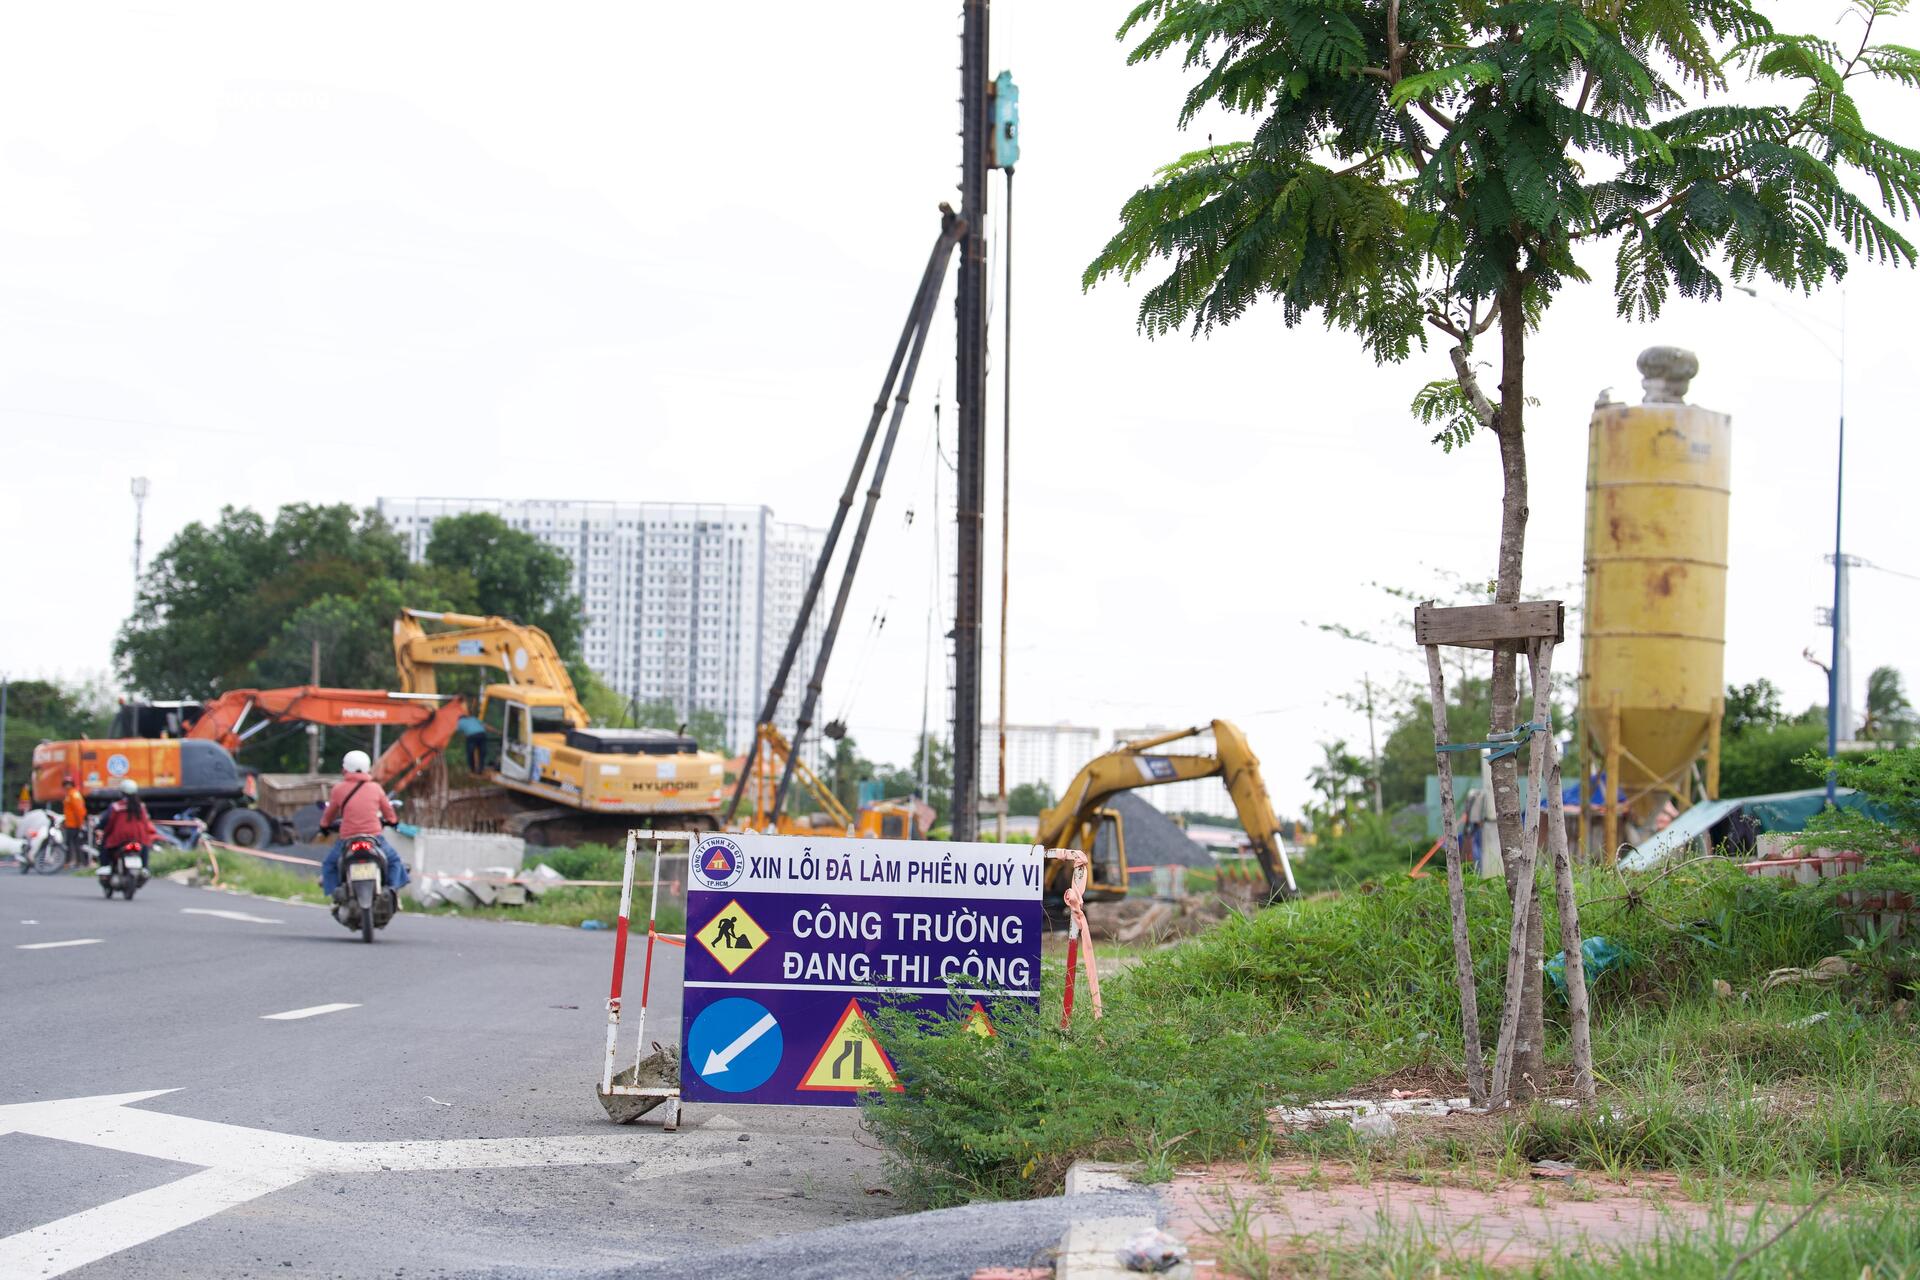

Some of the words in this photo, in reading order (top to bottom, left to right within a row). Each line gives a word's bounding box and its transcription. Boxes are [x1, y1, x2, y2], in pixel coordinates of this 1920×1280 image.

[342, 708, 388, 719] HITACHI
[632, 780, 699, 792] HYUNDAI
[707, 839, 725, 847] TNHH
[749, 856, 782, 879] XIN
[788, 847, 820, 881] LỖI
[826, 853, 853, 881] ĐÃ
[860, 854, 901, 883] LÀM
[908, 852, 967, 885] PHIỀN
[973, 858, 1015, 886] QUÝ
[1022, 864, 1040, 891] VỊ
[792, 903, 882, 941] CÔNG
[892, 907, 1023, 944] TRƯỜNG
[783, 951, 870, 982] ĐANG
[880, 954, 930, 983] THI
[940, 949, 1030, 986] CÔNG
